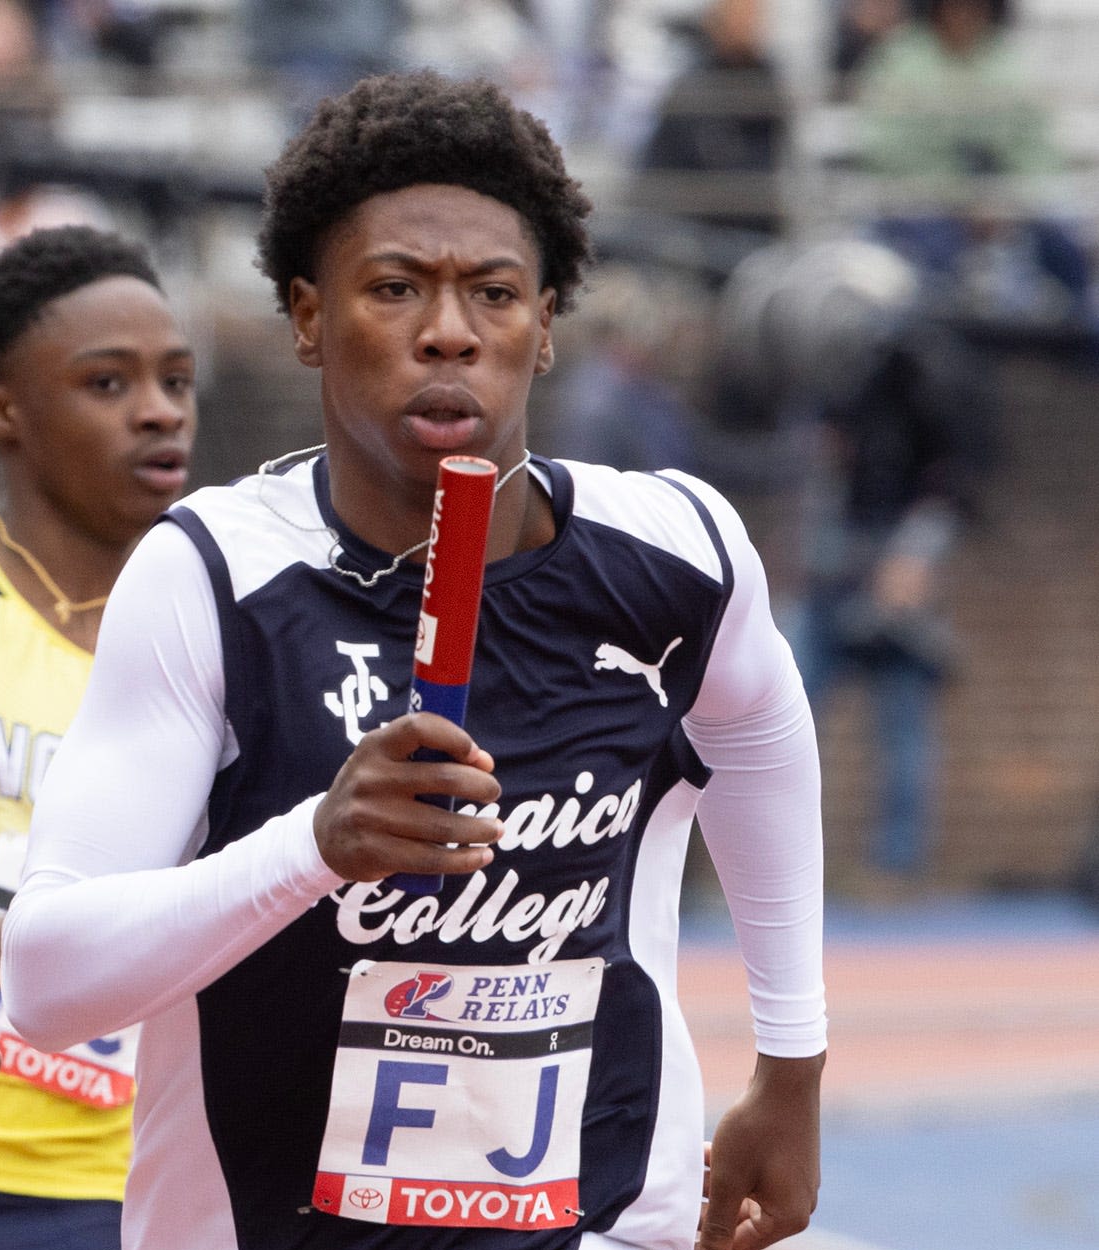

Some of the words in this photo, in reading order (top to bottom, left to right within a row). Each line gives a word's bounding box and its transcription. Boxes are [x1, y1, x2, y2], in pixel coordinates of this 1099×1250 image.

[329, 868, 611, 965] College
[467, 973, 552, 998] PENN
[458, 994, 570, 1022] RELAYS
[384, 1029, 454, 1052] Dream
[458, 1035, 495, 1056] On.
[2, 1038, 115, 1105] TOYOTA
[361, 1060, 449, 1166] F
[485, 1064, 560, 1178] J
[401, 1187, 555, 1222] TOYOTA
